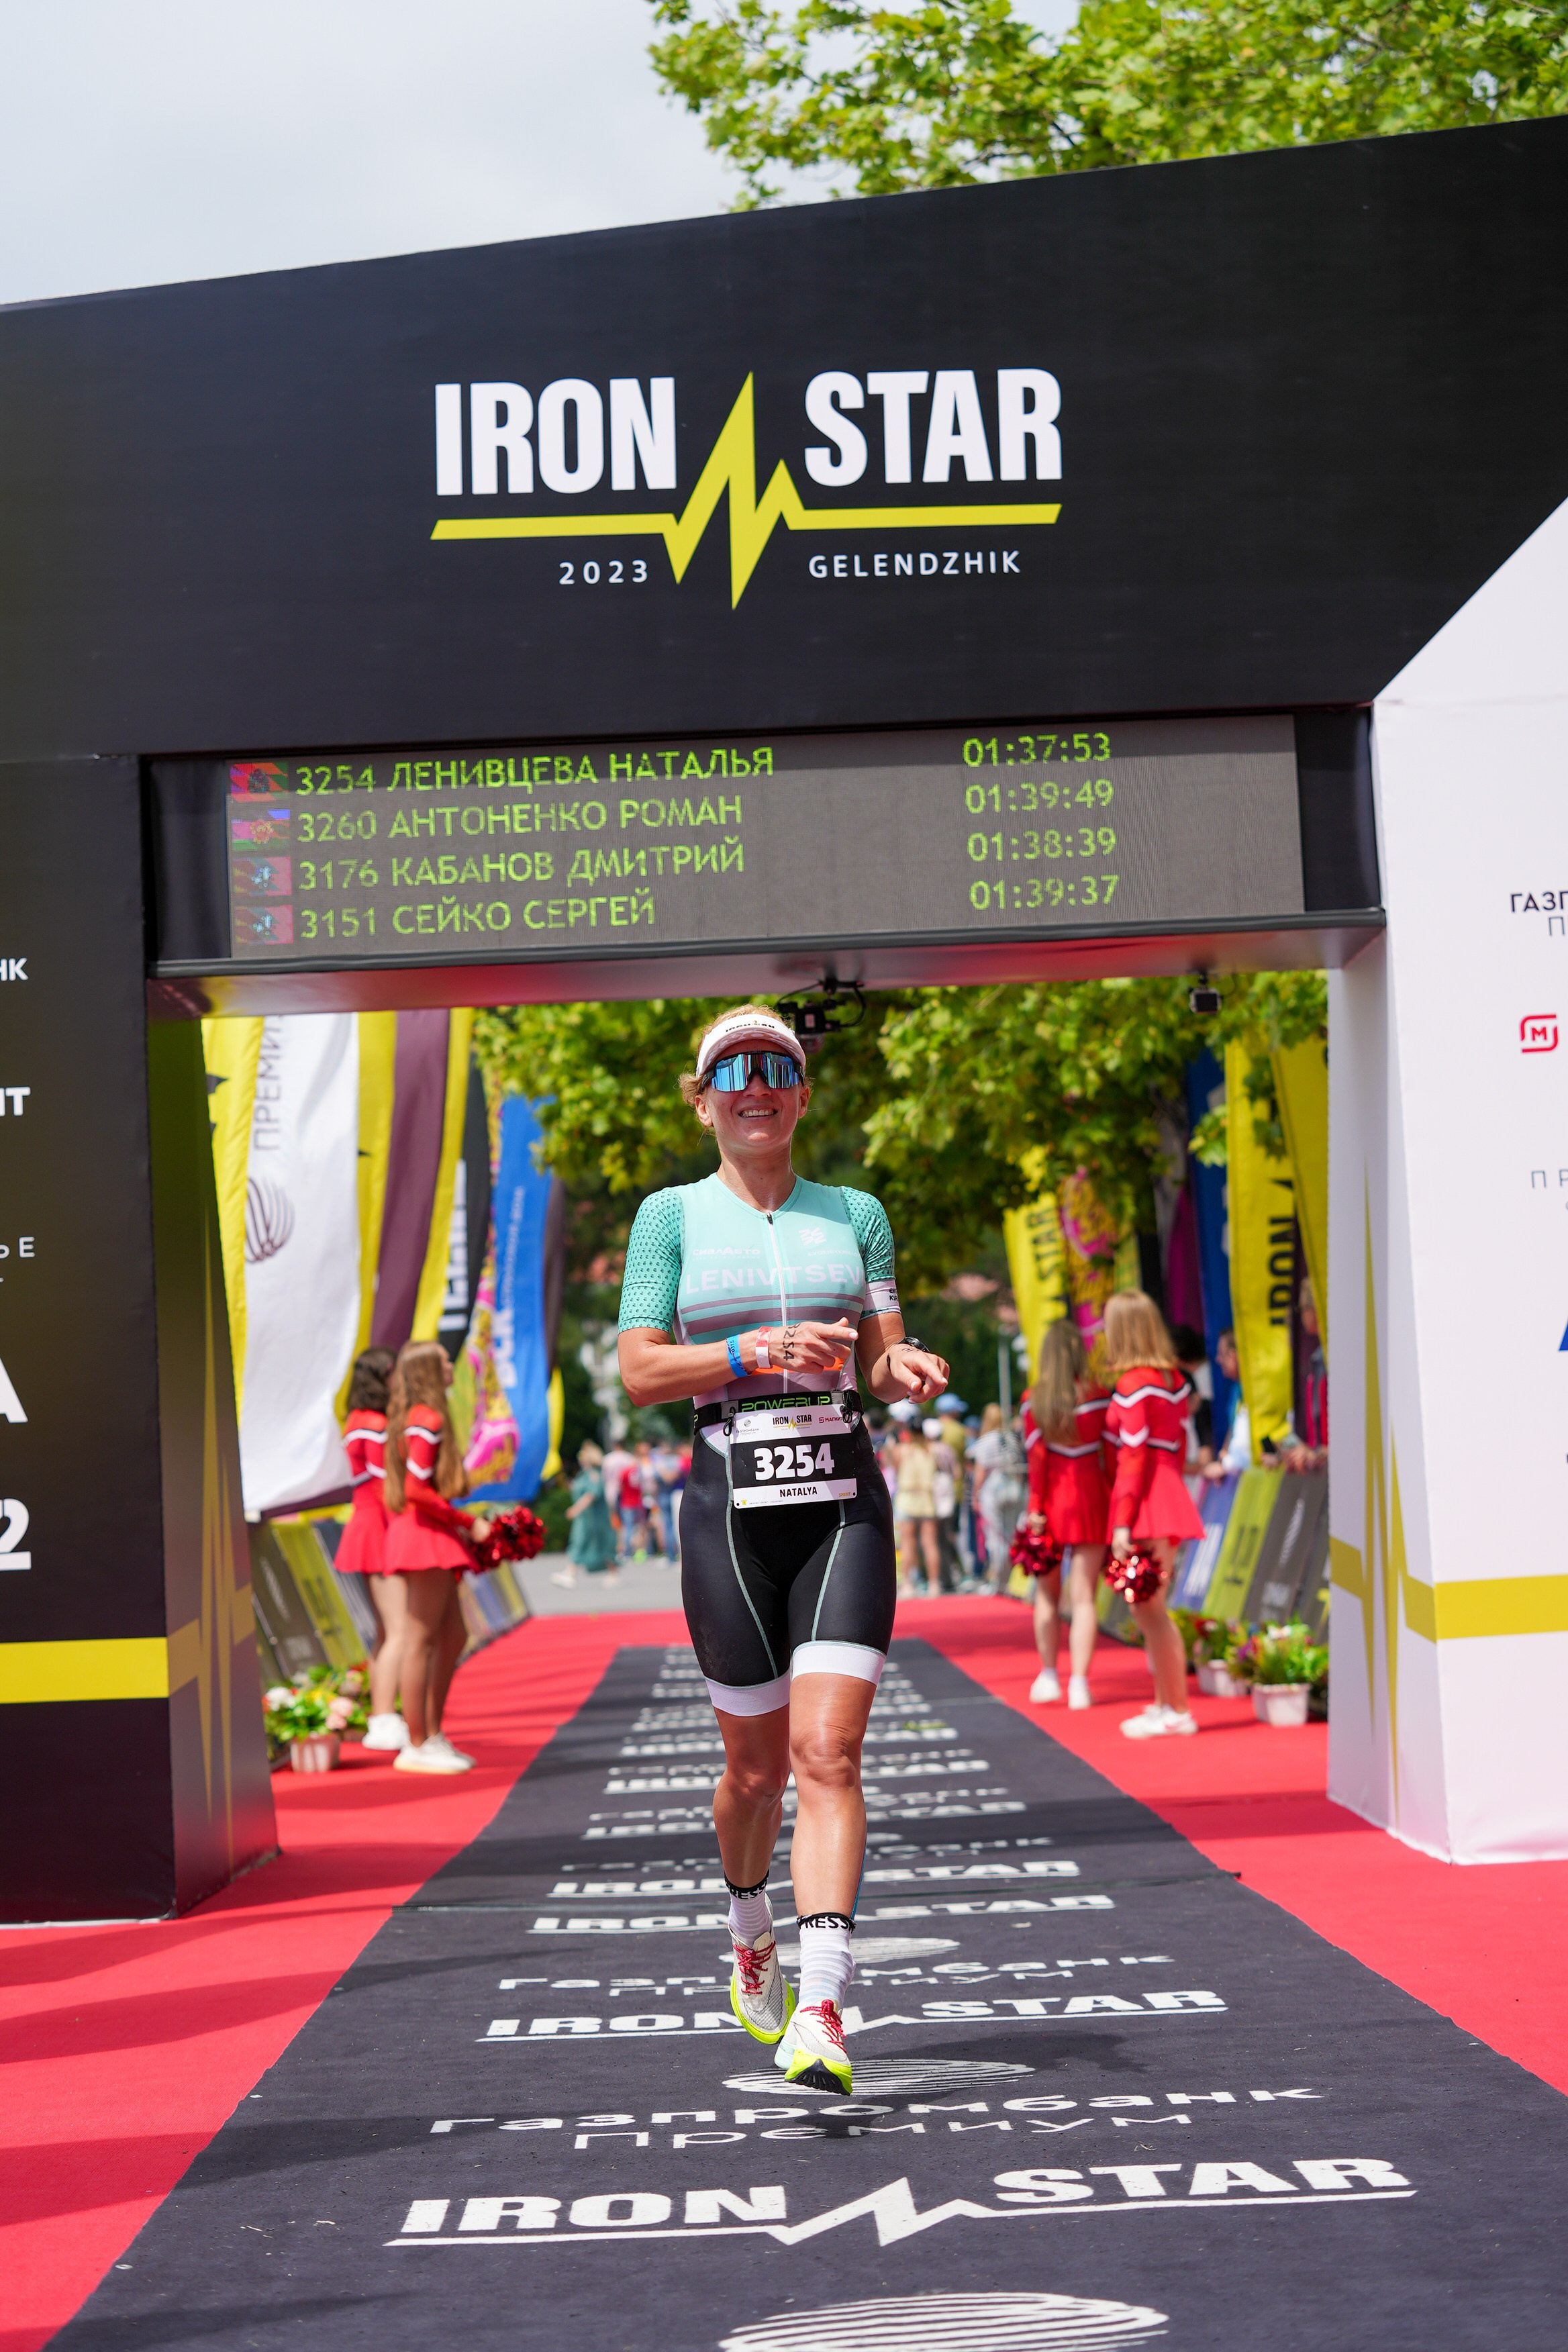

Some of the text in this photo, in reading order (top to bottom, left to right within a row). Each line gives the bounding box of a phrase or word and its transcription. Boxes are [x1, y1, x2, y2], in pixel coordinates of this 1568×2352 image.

[434, 369, 1063, 496] IRON STAR
[558, 551, 1021, 585] 2023 GELENDZHIK
[295, 732, 1112, 795] 3254 ЛЕНИВЦЕВА НАТАЛЬЯ 01:37:53
[297, 778, 1115, 842] 3260 АНТОНЕНКО РОМАН 01:39:49
[299, 826, 1118, 891] 3176 КАБАНОВ ДМИТРИЙ 01:38:39
[300, 873, 1121, 939] 3151 СЕЙКО СЕРГЕЙ 01:39:37
[773, 1414, 812, 1425] IRON STAR
[753, 1442, 835, 1481] 3254
[779, 1486, 818, 1498] NATALYA
[922, 1990, 1228, 2018] STAR
[430, 2088, 1325, 2134] Газпромбанк
[574, 2114, 1193, 2149] Премиум
[401, 2158, 1413, 2233] IRON STAR
